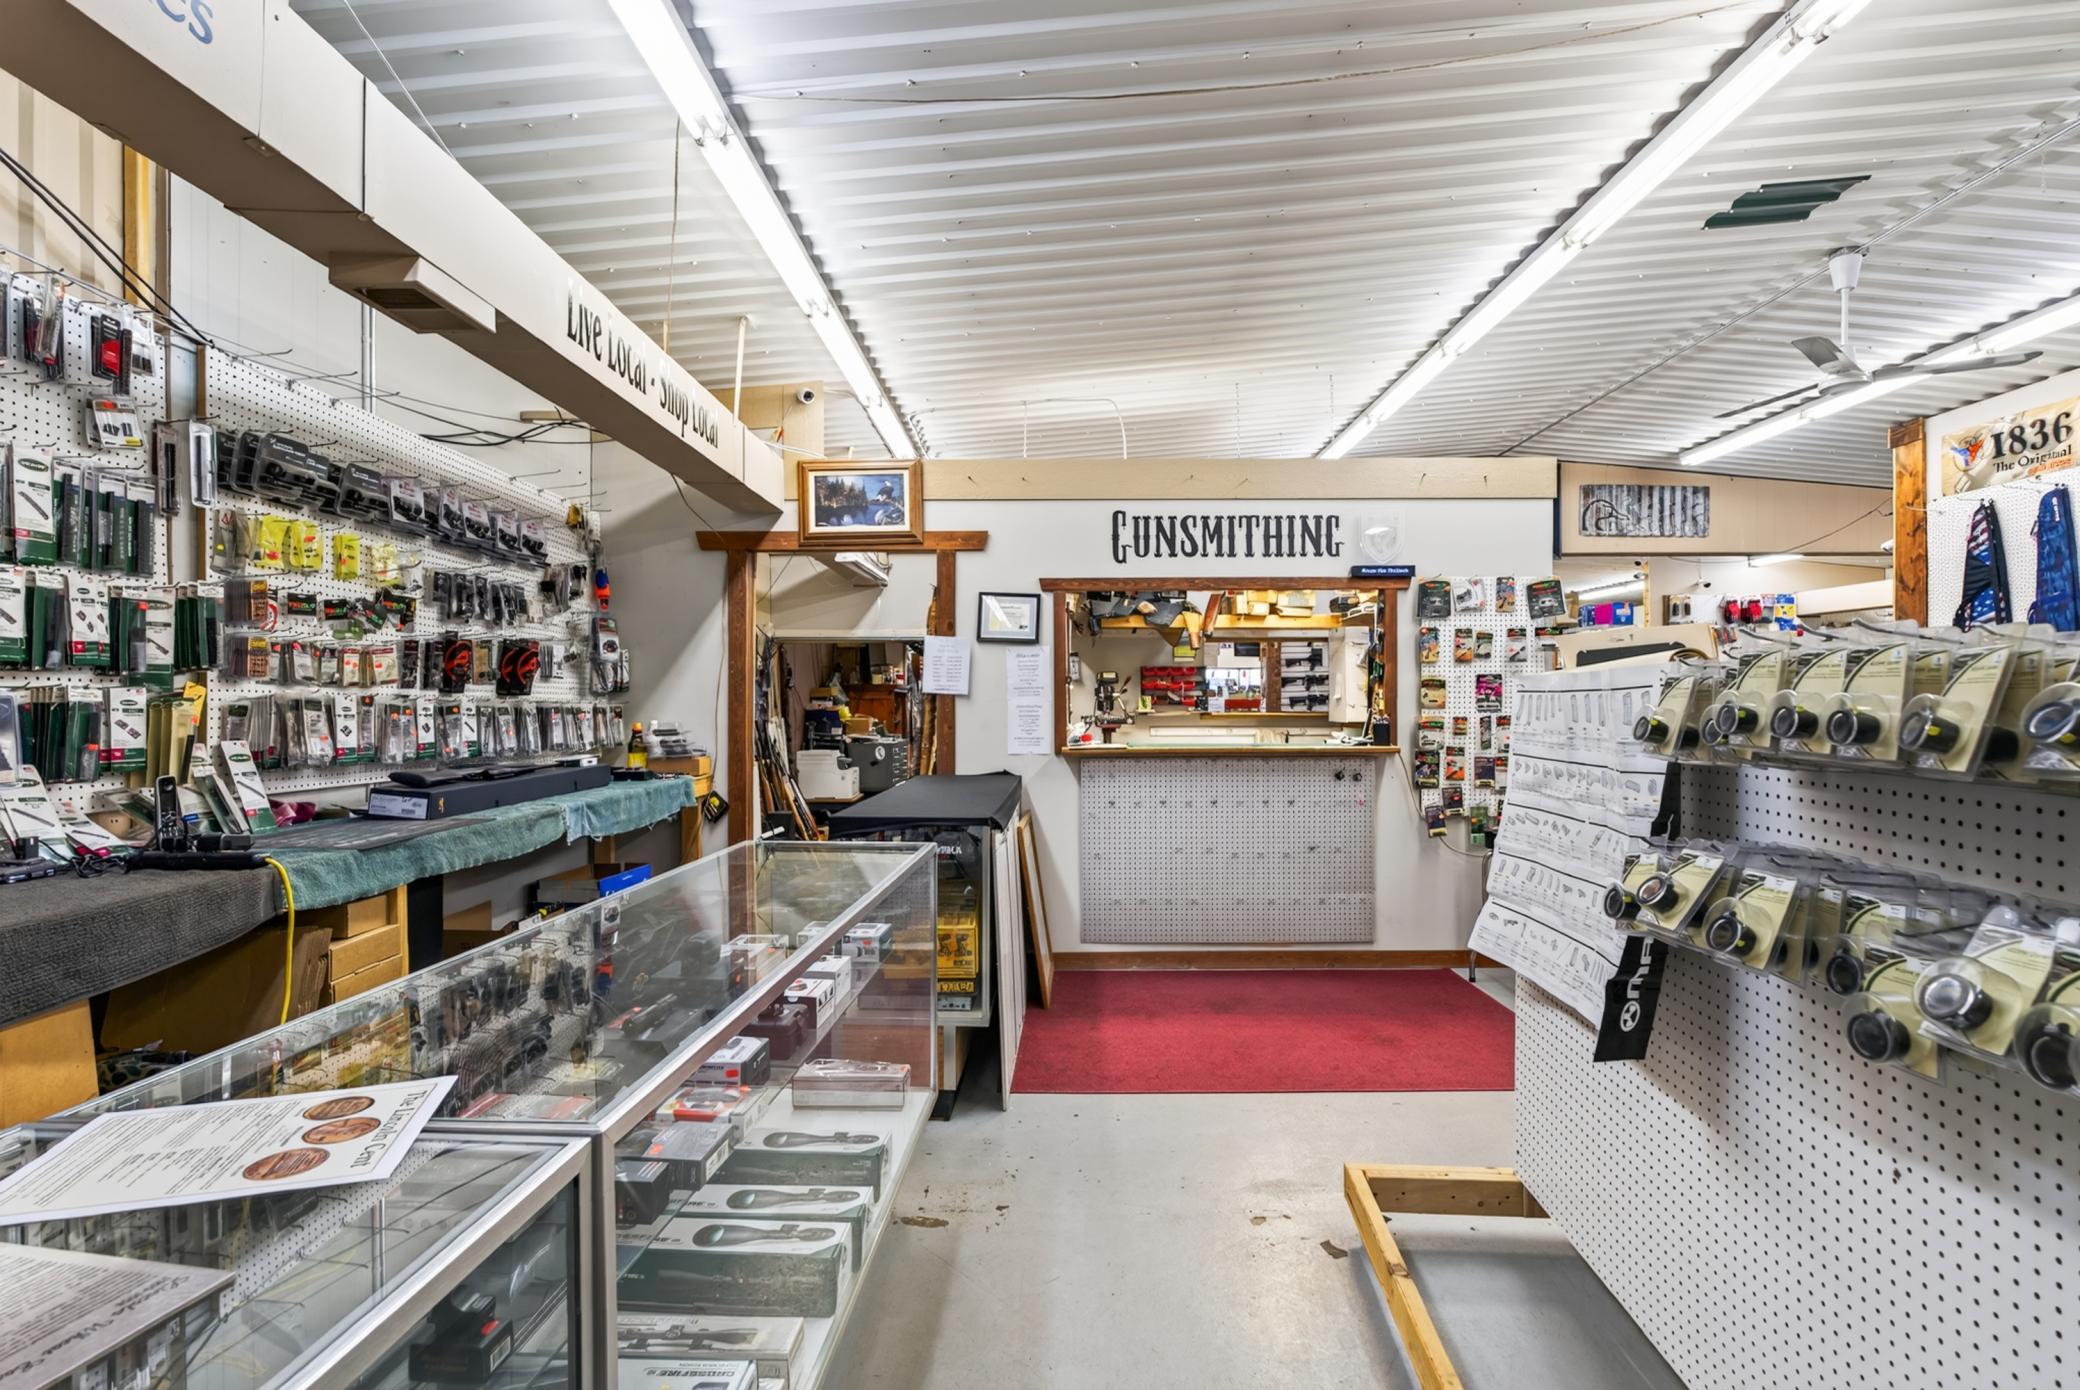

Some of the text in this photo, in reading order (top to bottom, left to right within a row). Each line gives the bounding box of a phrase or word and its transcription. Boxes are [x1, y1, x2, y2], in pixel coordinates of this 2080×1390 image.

[1990, 411, 2072, 460] 1836
[1993, 461, 2015, 473] The
[2018, 444, 2072, 467] Original
[1111, 510, 1345, 563] GUNSMITHING
[350, 1090, 428, 1168] The Lincoln Cent
